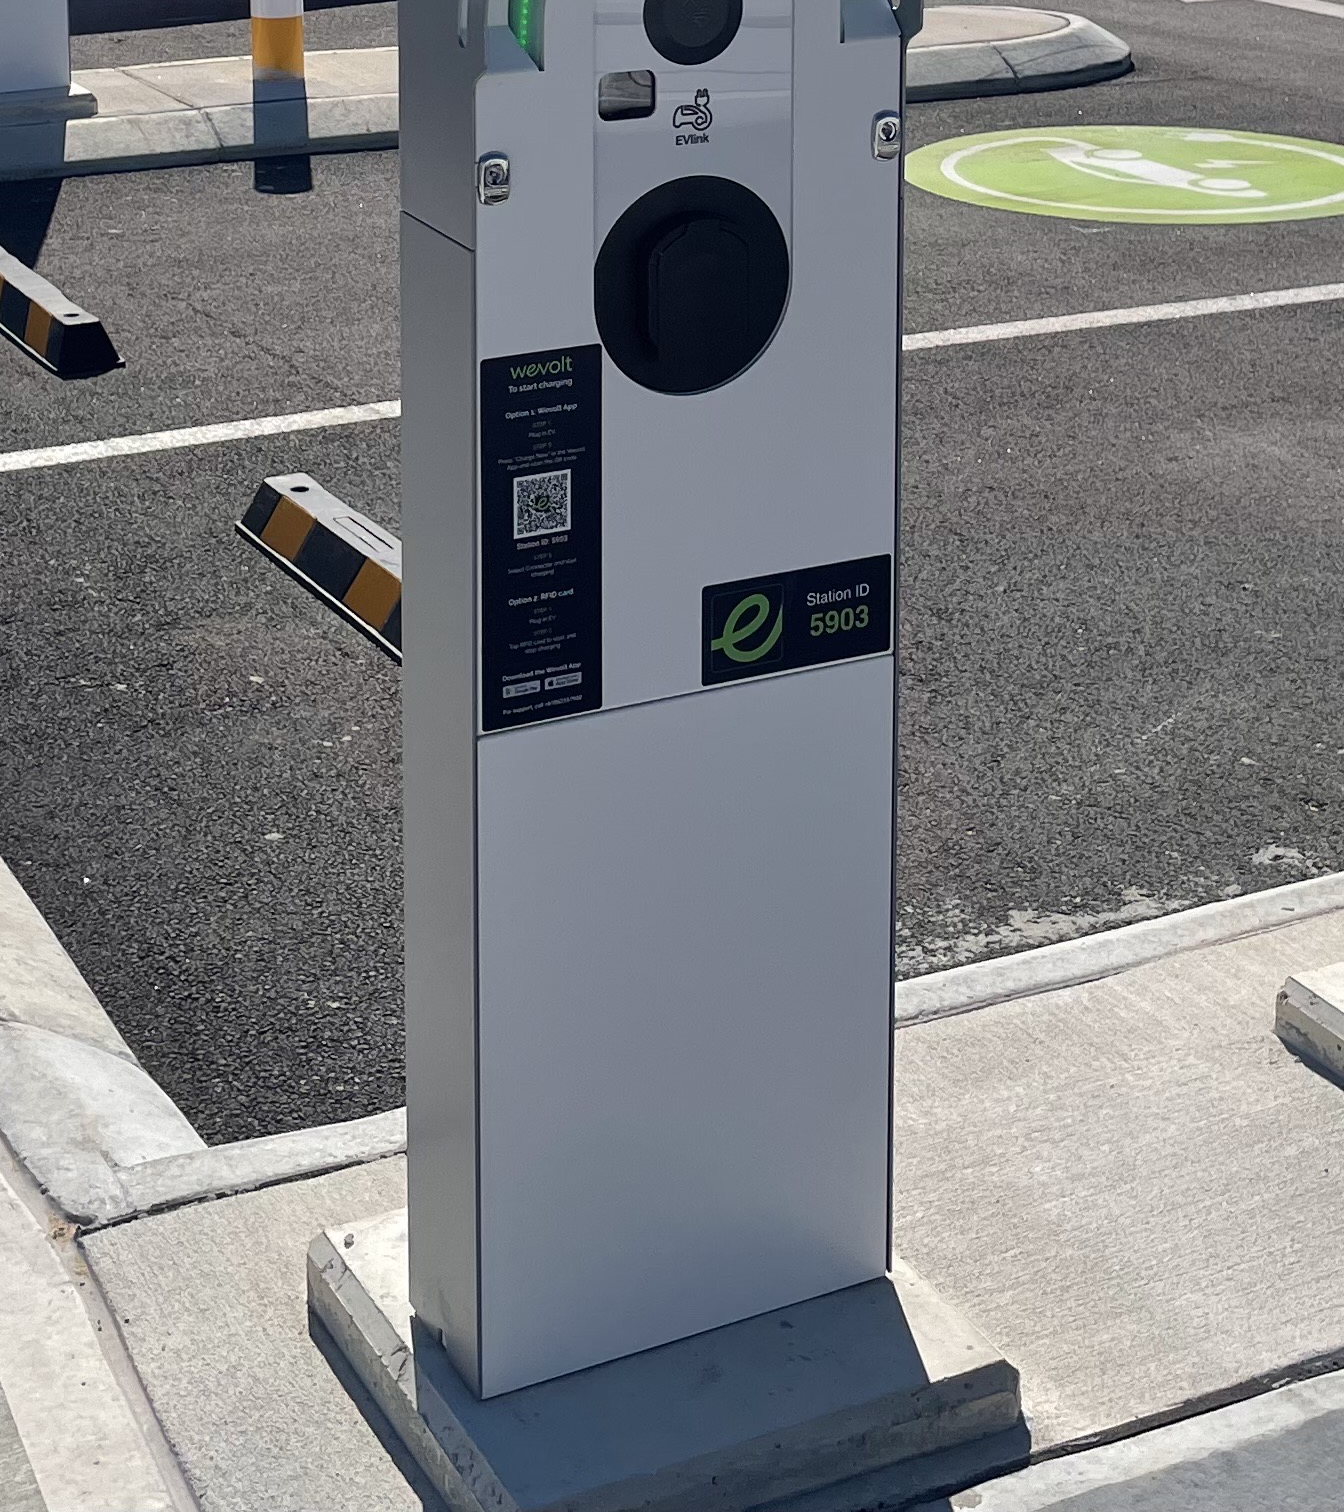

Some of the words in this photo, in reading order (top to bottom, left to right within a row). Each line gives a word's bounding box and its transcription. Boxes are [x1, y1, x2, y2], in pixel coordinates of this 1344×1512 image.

[675, 132, 710, 146] EVlink
[510, 355, 573, 380] wevolt
[508, 385, 518, 393] To
[519, 382, 537, 392] start
[538, 378, 573, 388] charging
[806, 588, 852, 606] Station
[855, 583, 870, 598] ID
[809, 604, 869, 637] 5903
